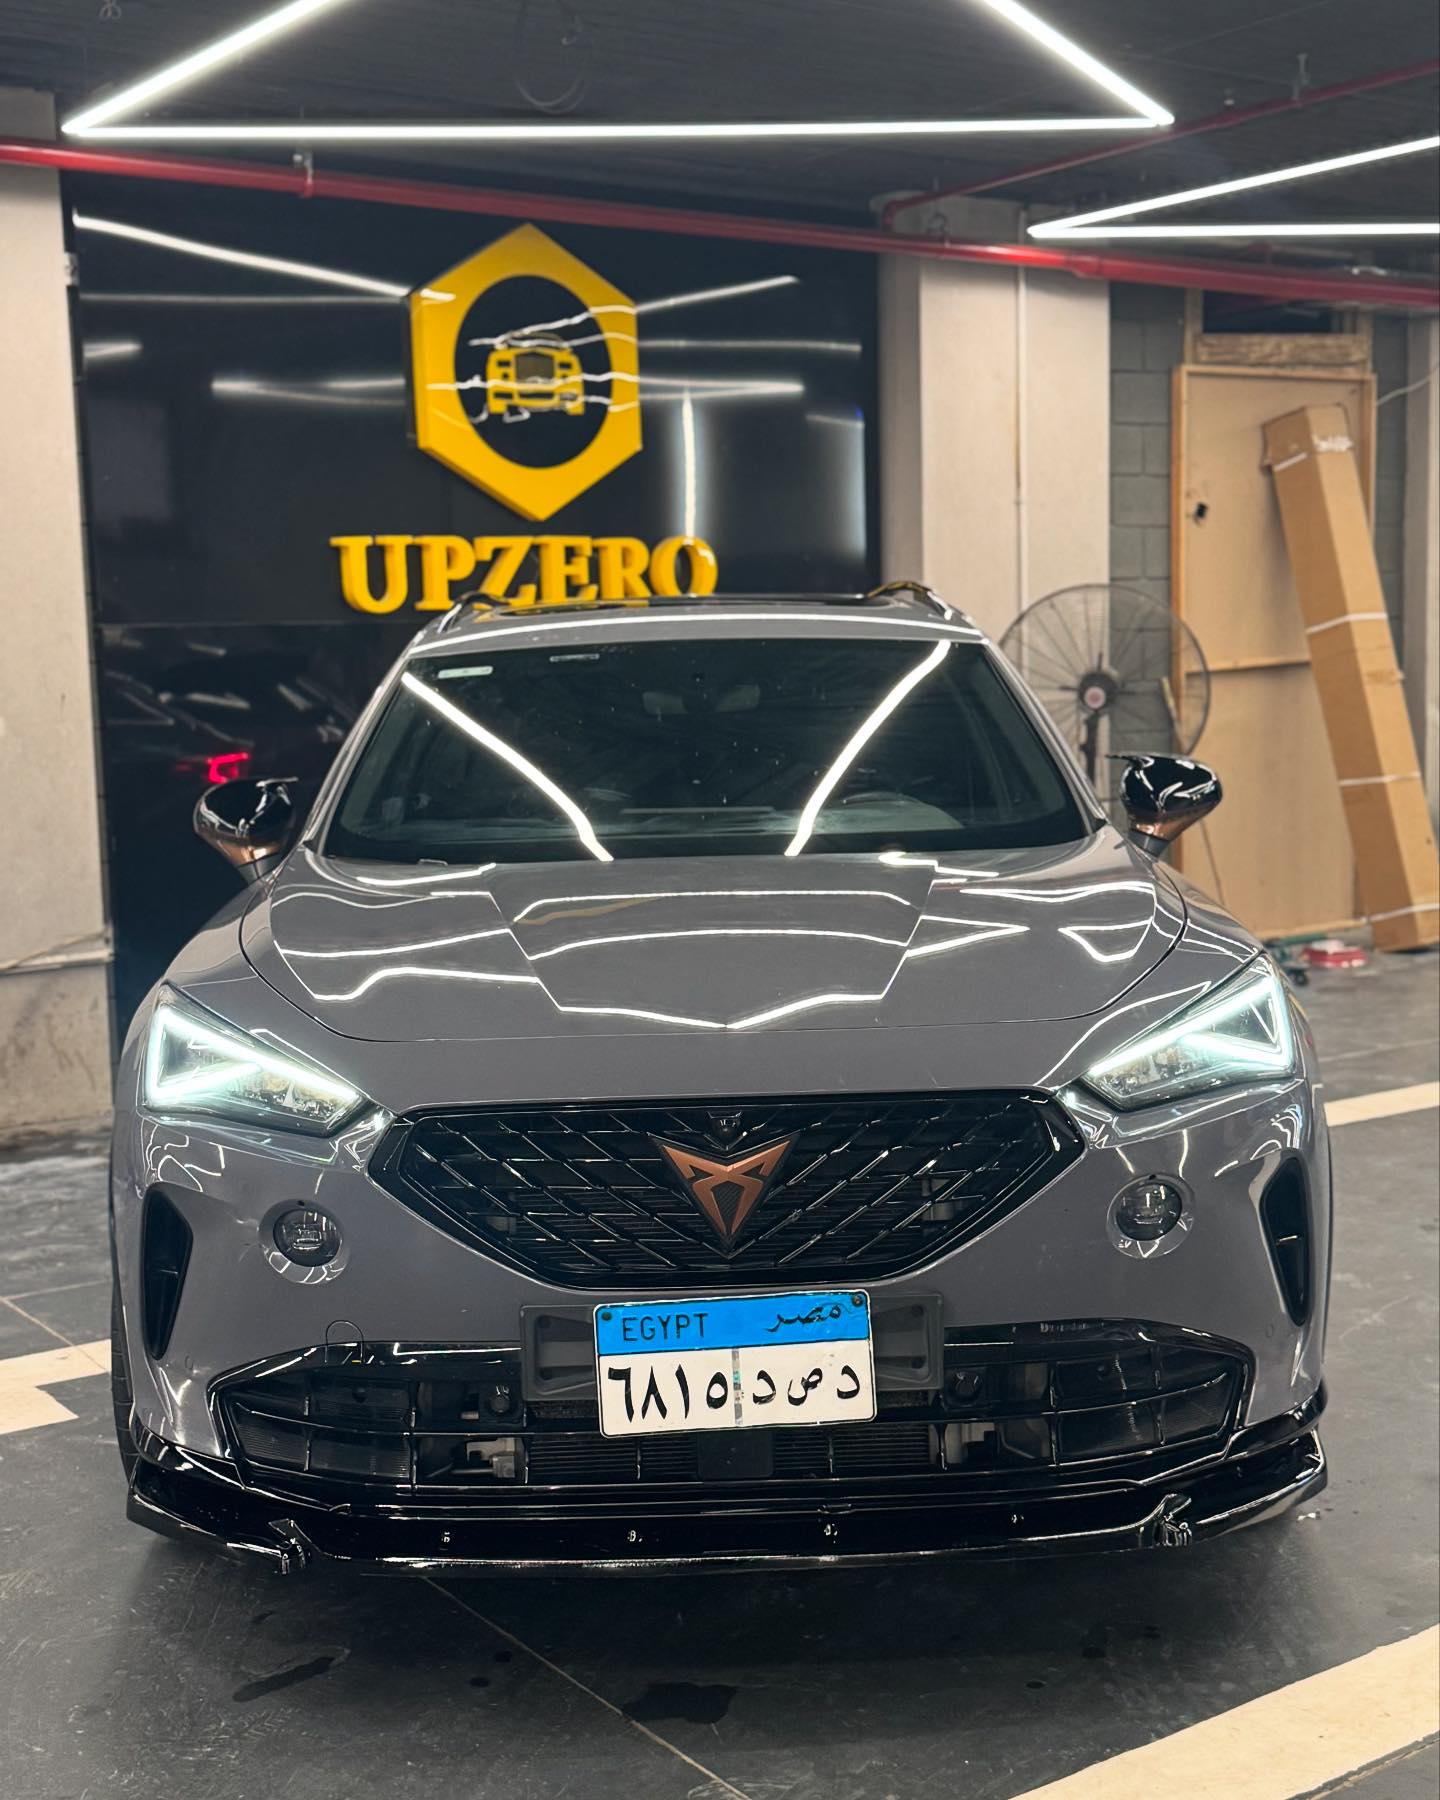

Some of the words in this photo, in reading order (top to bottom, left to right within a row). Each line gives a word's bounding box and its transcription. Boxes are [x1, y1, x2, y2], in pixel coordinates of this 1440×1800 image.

[330, 535, 718, 614] UPZERO
[622, 1312, 709, 1342] EGYPT
[764, 1303, 842, 1333] مصر
[607, 1363, 729, 1423] ٦٨١٥
